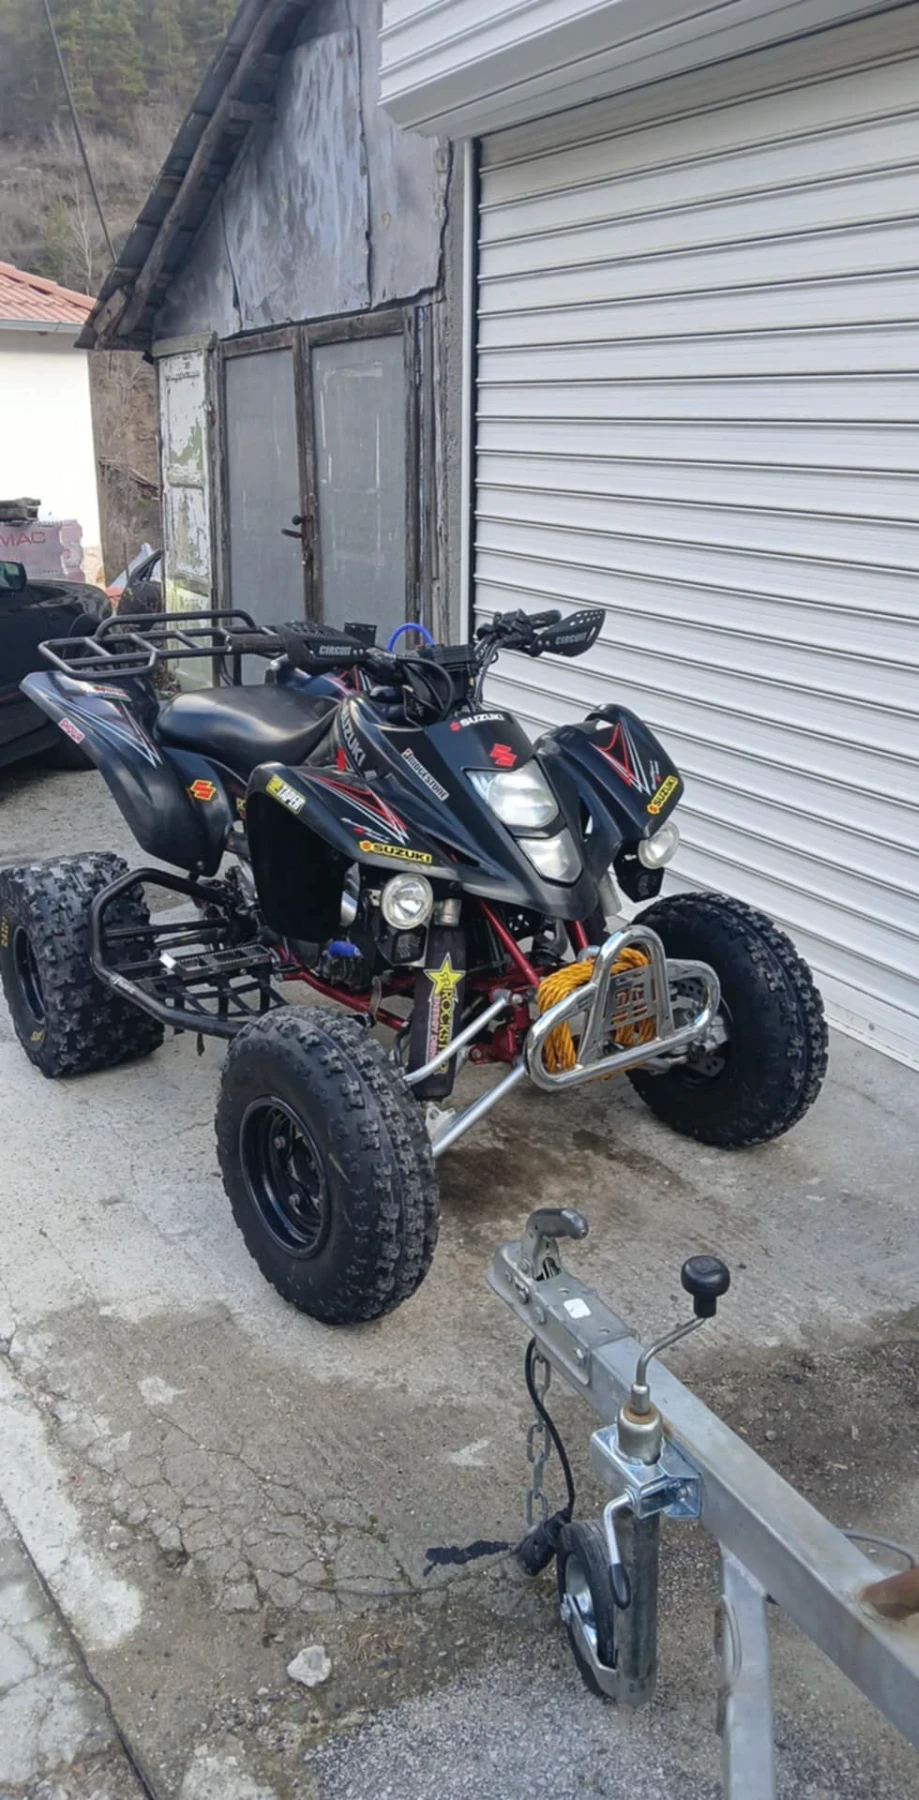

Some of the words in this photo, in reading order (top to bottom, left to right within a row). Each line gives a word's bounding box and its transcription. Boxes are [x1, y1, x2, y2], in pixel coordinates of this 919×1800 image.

[554, 632, 588, 646] CIRCUIT
[318, 645, 352, 656] CIRCUIT
[460, 712, 505, 728] SUZUKI
[402, 749, 448, 800] BRIDGESTONE
[653, 776, 677, 806] SUZUKI
[372, 843, 431, 862] SUZUKI
